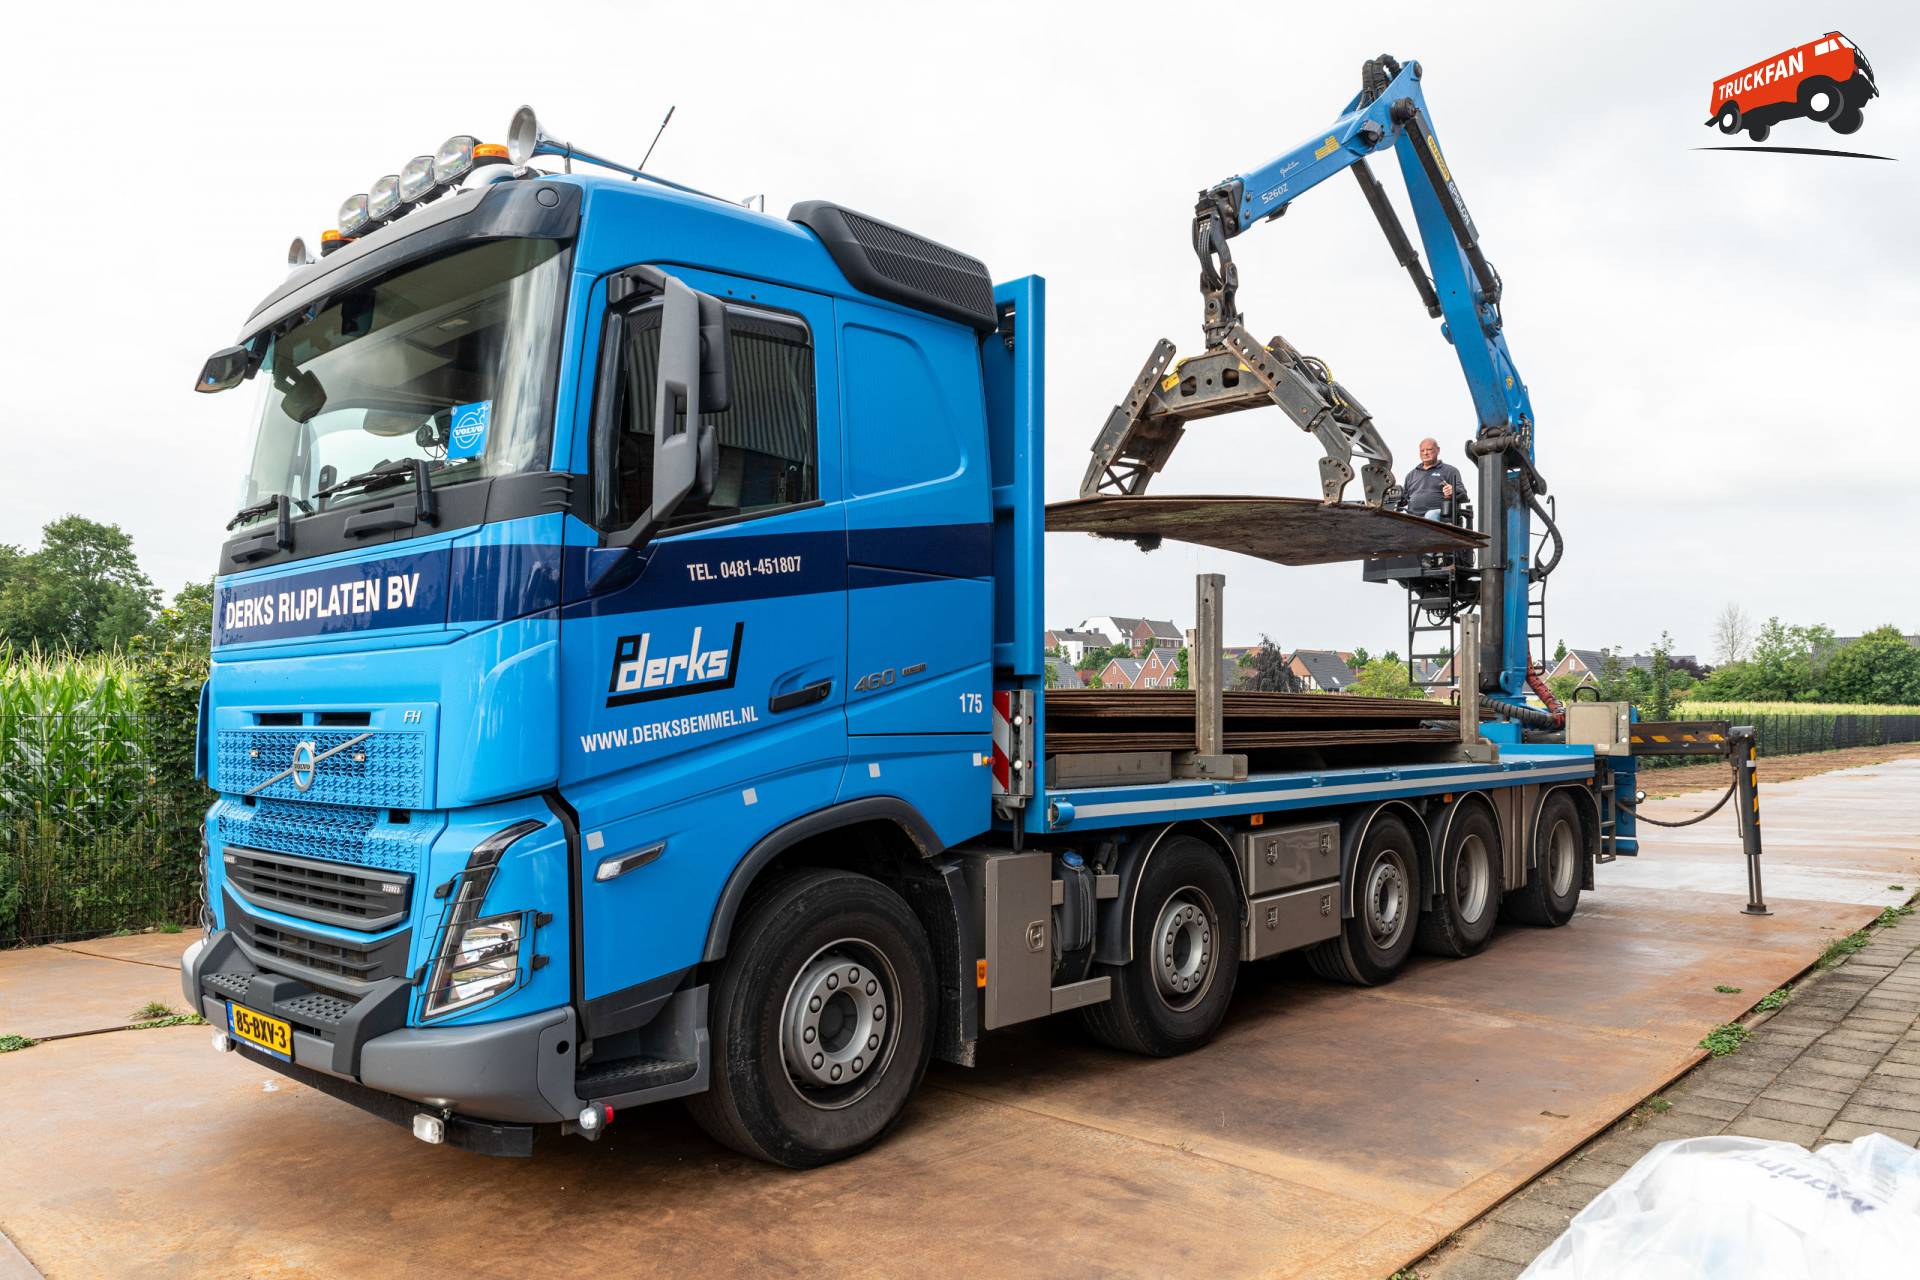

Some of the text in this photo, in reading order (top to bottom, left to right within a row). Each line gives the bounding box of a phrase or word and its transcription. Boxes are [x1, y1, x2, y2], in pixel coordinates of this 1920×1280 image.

[455, 424, 483, 437] VOLVO
[686, 555, 801, 581] TEL. 0481-451807
[225, 572, 420, 630] DERKS RIJPLATEN BV
[853, 668, 896, 692] 460
[959, 692, 983, 714] 175
[403, 710, 422, 724] FH
[580, 705, 759, 753] WWW.DERKSBEMMEL.NL
[236, 1010, 287, 1049] 85-BXV-3
